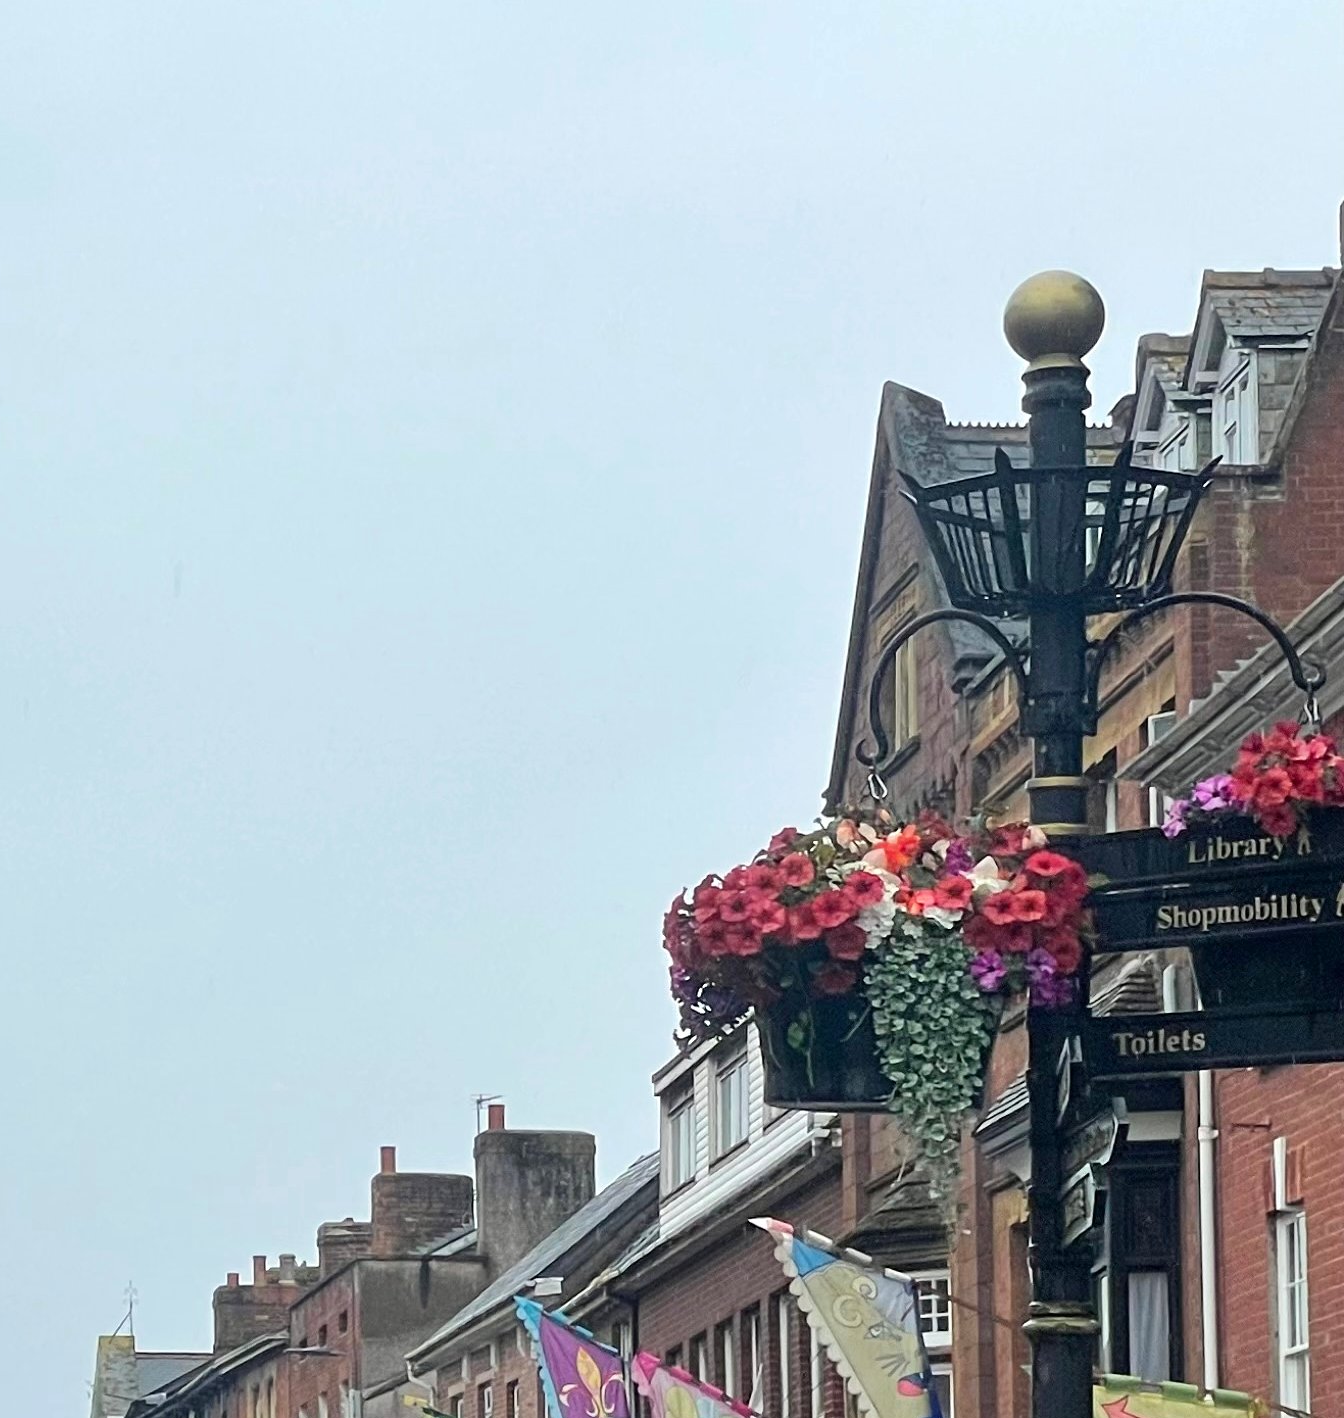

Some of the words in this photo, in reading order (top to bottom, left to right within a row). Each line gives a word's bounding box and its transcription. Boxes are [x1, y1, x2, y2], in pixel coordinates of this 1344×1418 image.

[1188, 836, 1287, 864] Library
[1157, 894, 1325, 932] Shopmobility
[1115, 1029, 1206, 1056] Toilets
